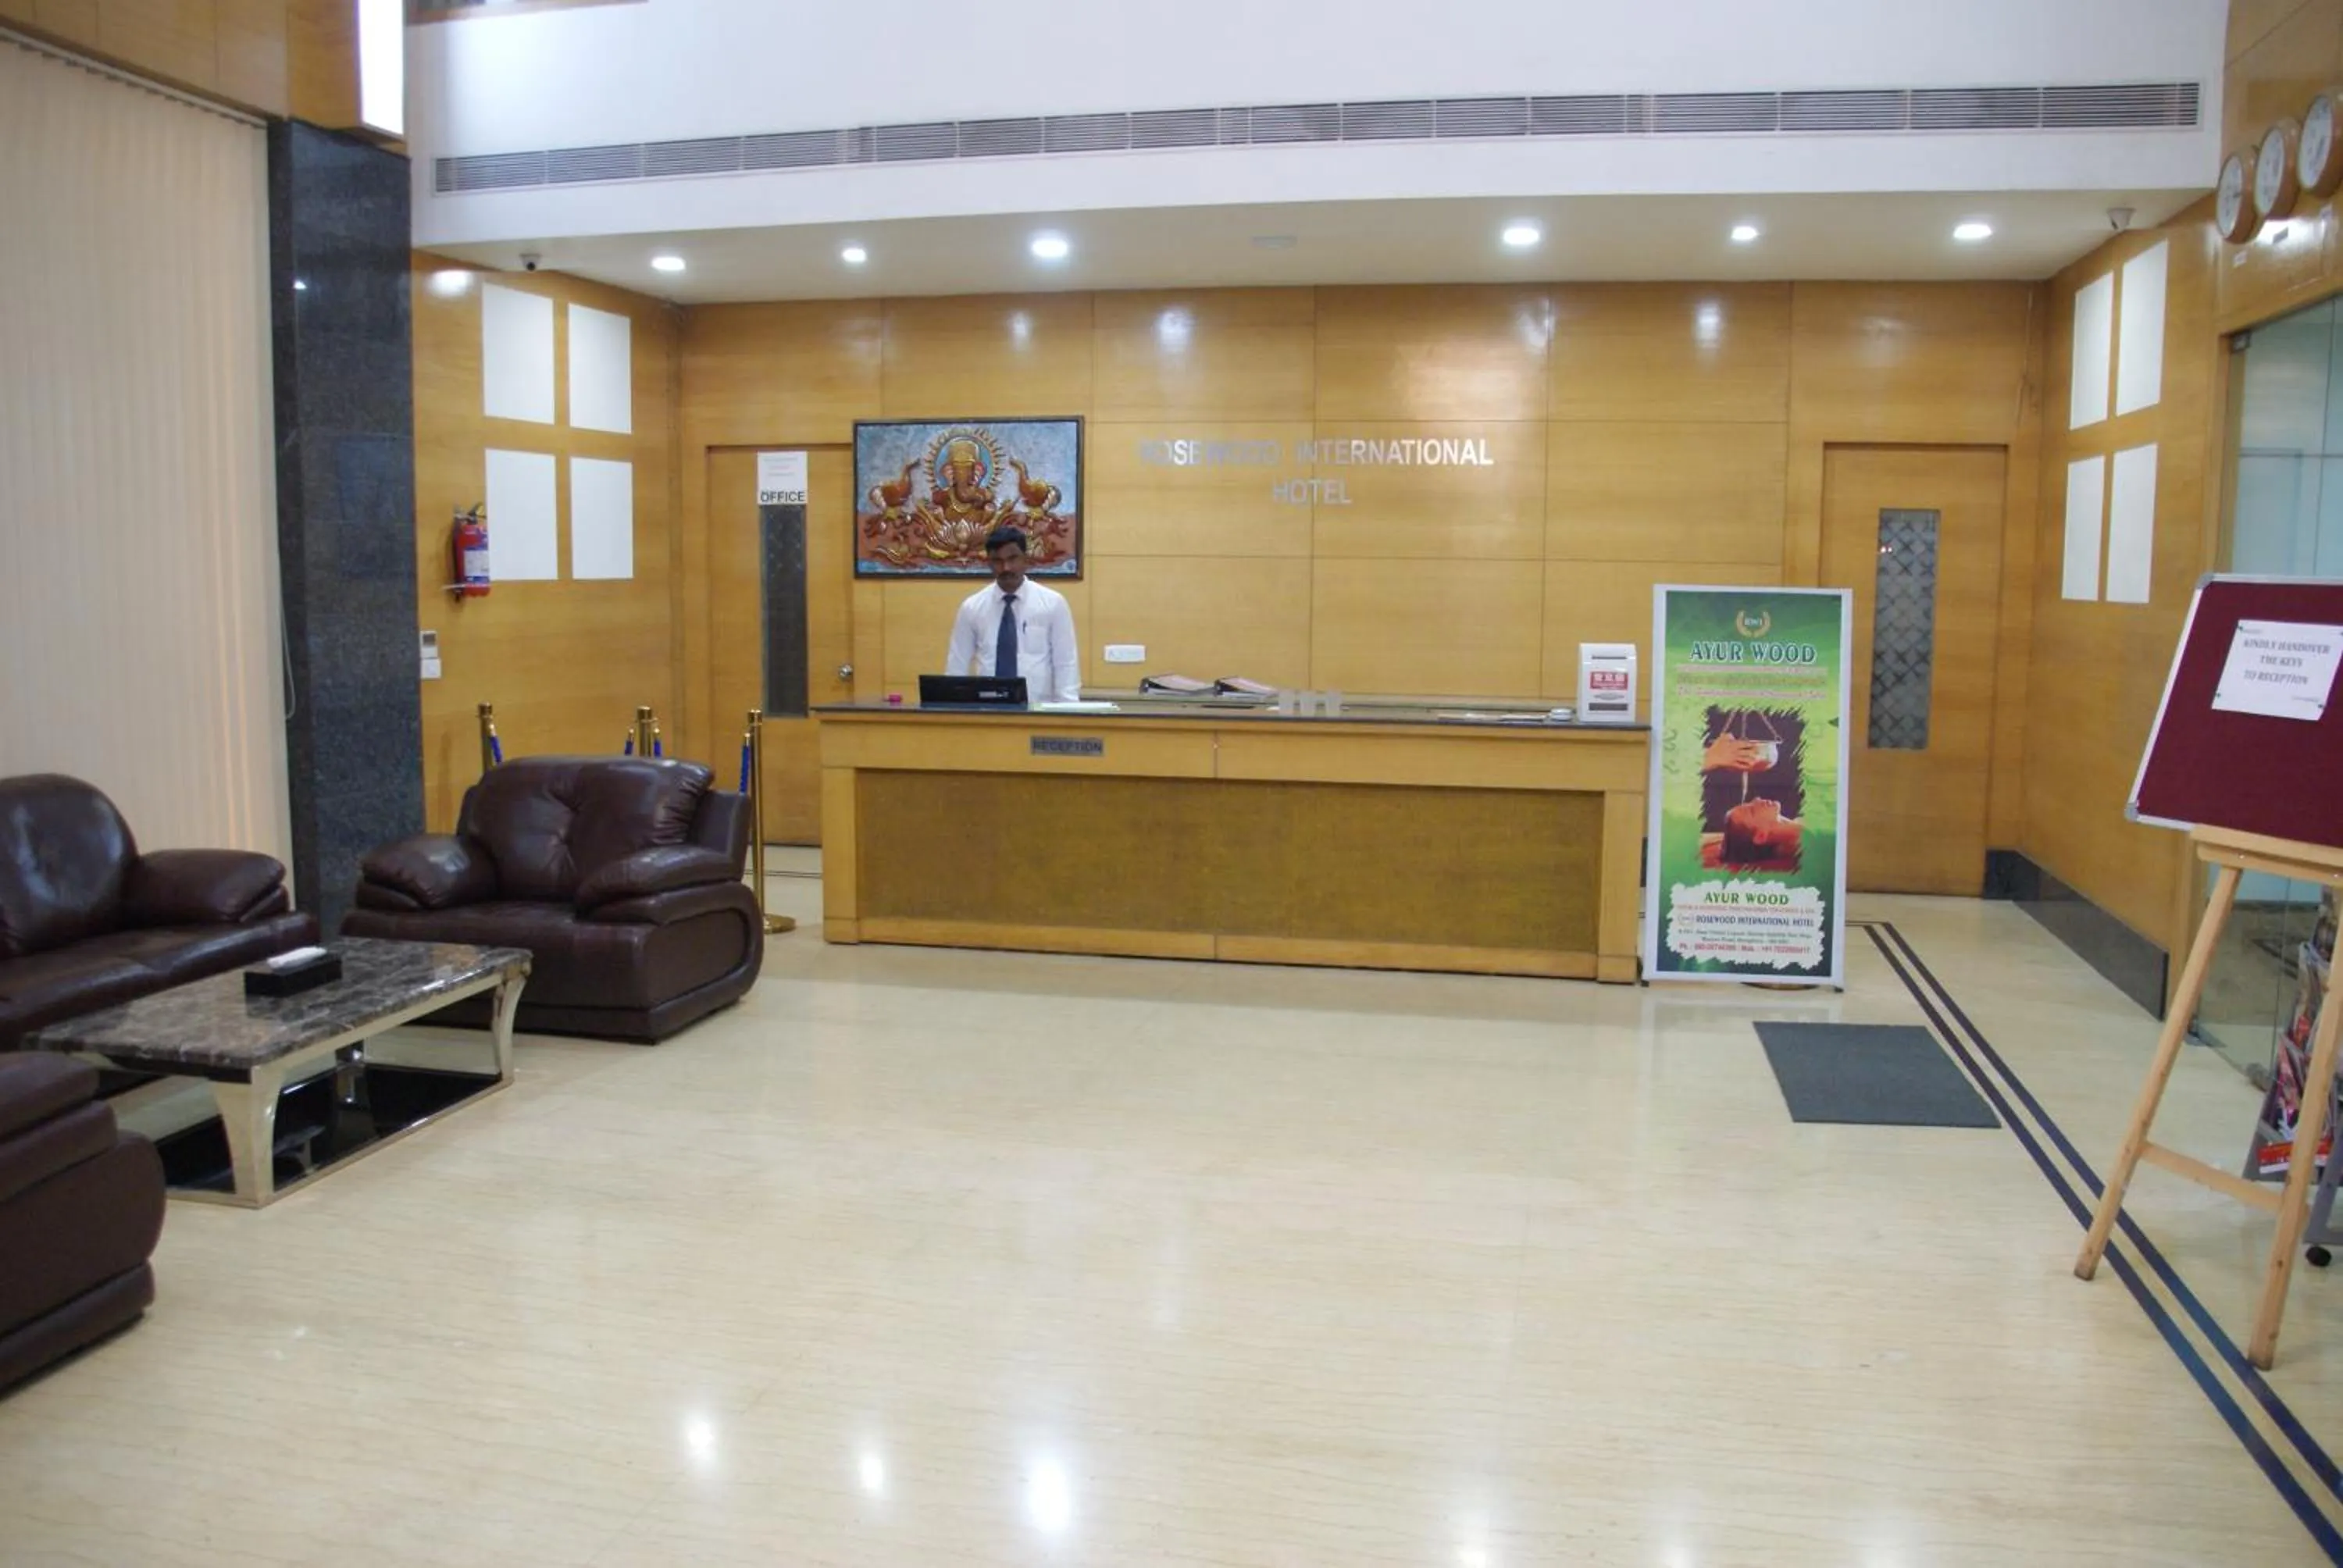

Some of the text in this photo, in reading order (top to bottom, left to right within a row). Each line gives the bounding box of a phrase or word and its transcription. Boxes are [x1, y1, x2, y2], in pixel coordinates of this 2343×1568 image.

[1296, 438, 1494, 466] INTERNATIONAL
[760, 490, 806, 502] OFFICE
[1272, 477, 1353, 505] HOTEL
[1690, 640, 1817, 665] AYUR WOOD
[1032, 739, 1102, 754] RECEPTION
[1704, 891, 1789, 905] AYUR WOOD
